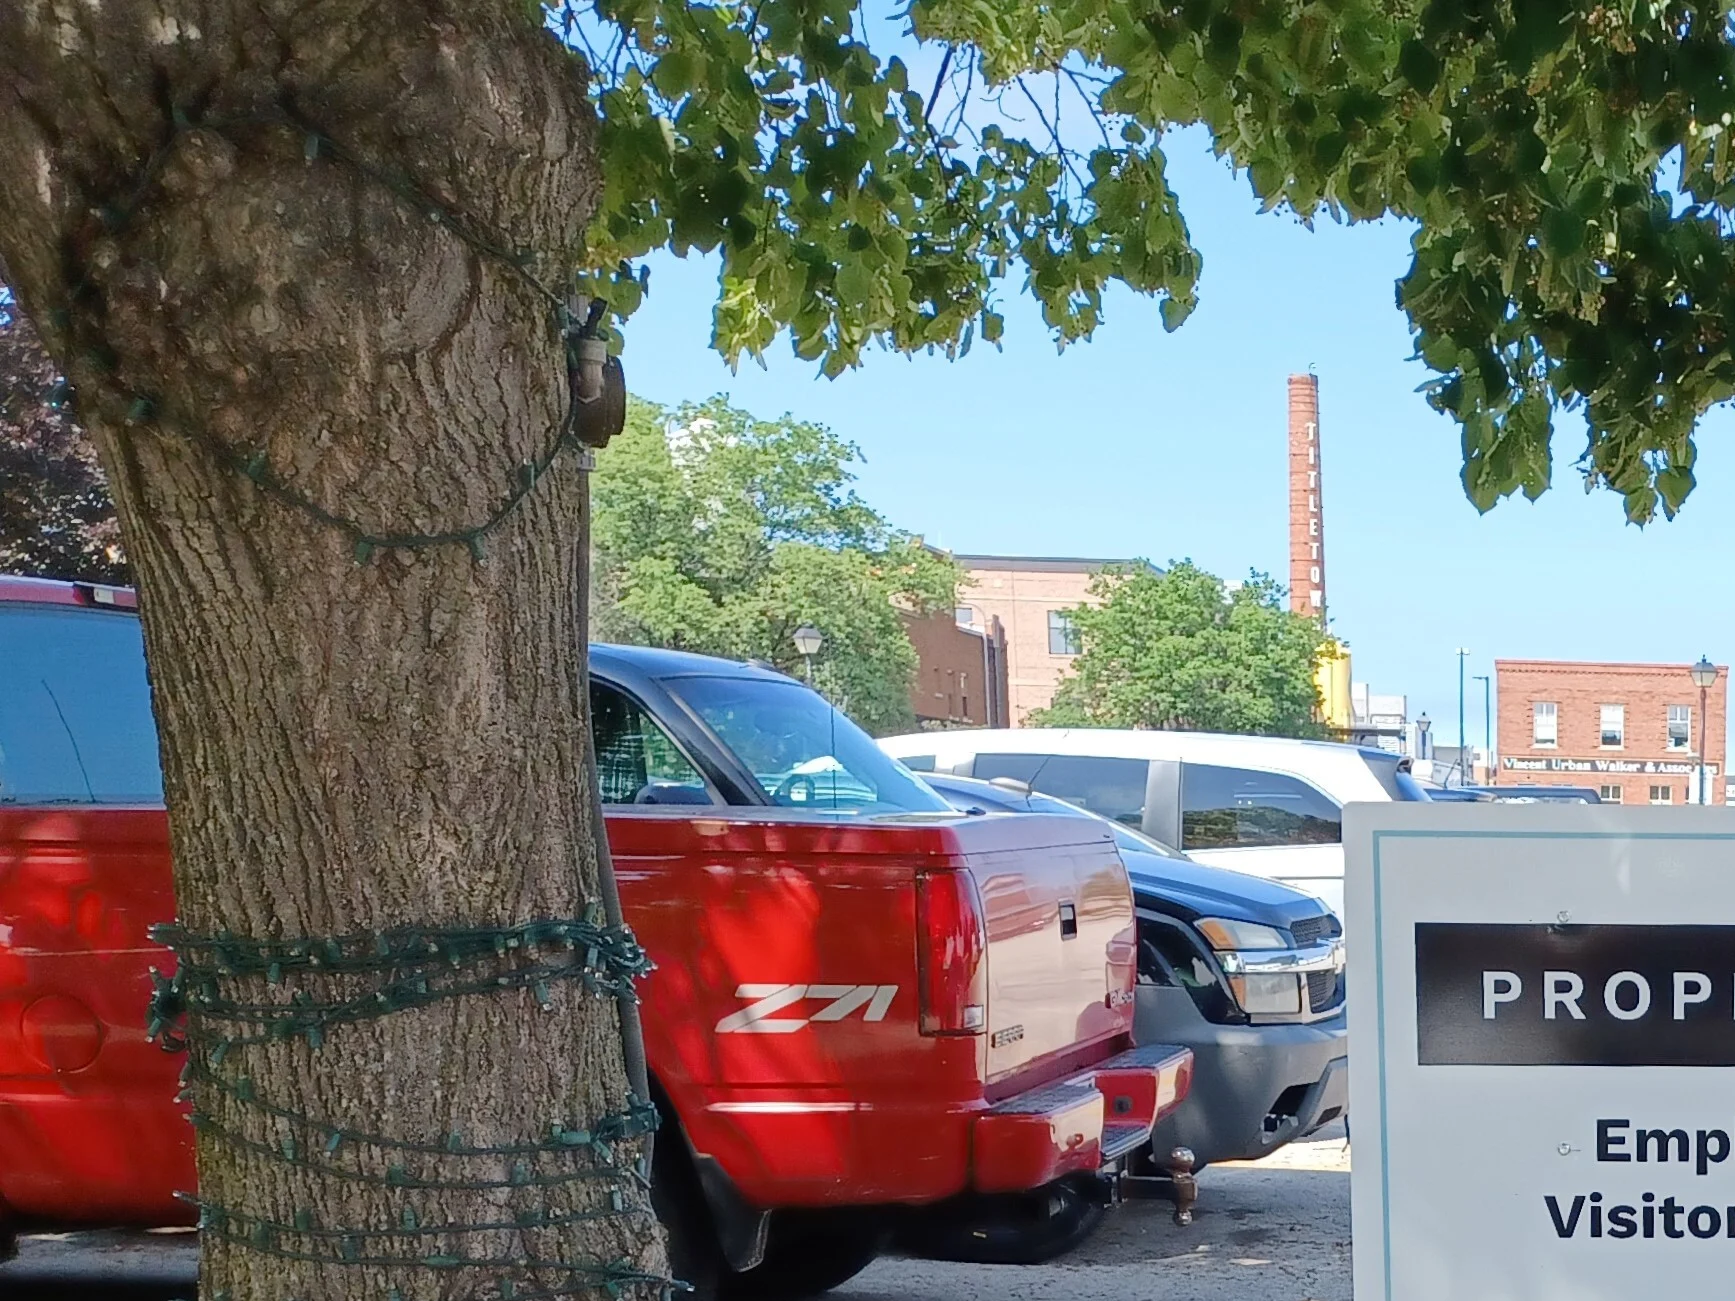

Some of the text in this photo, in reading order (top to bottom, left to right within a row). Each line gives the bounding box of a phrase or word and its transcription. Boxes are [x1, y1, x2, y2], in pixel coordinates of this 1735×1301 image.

[1551, 759, 1591, 771] Urban
[1595, 760, 1641, 772] Walker
[1644, 761, 1655, 773] &
[714, 983, 899, 1033] Z71
